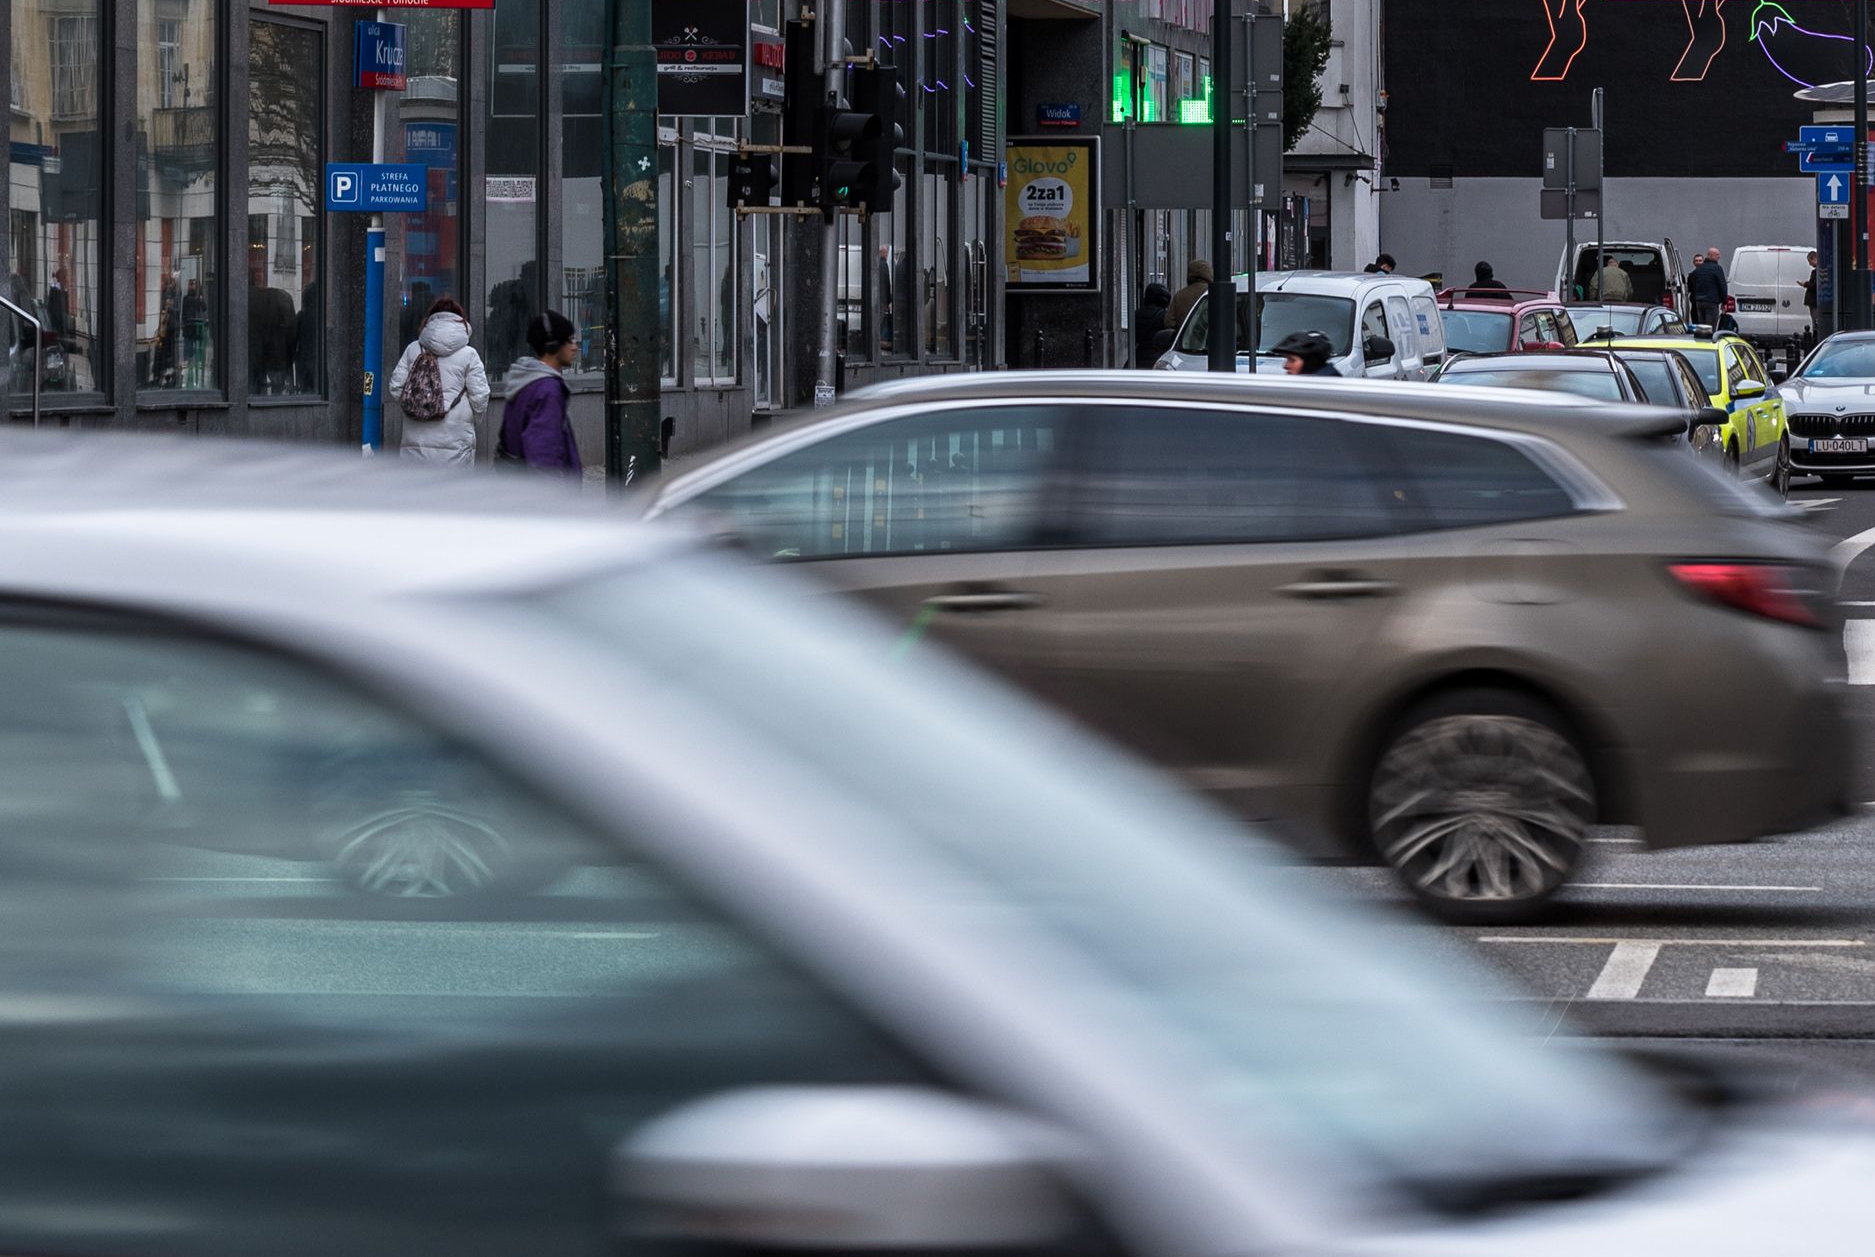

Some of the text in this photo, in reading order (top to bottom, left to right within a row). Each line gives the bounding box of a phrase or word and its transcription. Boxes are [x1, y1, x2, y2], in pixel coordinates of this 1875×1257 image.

[1046, 109, 1072, 119] Widok
[1014, 157, 1069, 175] Glovo
[381, 172, 409, 181] STREFA
[370, 182, 419, 193] PŁATNEGO
[1026, 185, 1064, 201] 2za1
[370, 195, 419, 205] PARKOWANIA
[1832, 440, 1865, 452] 040LT
